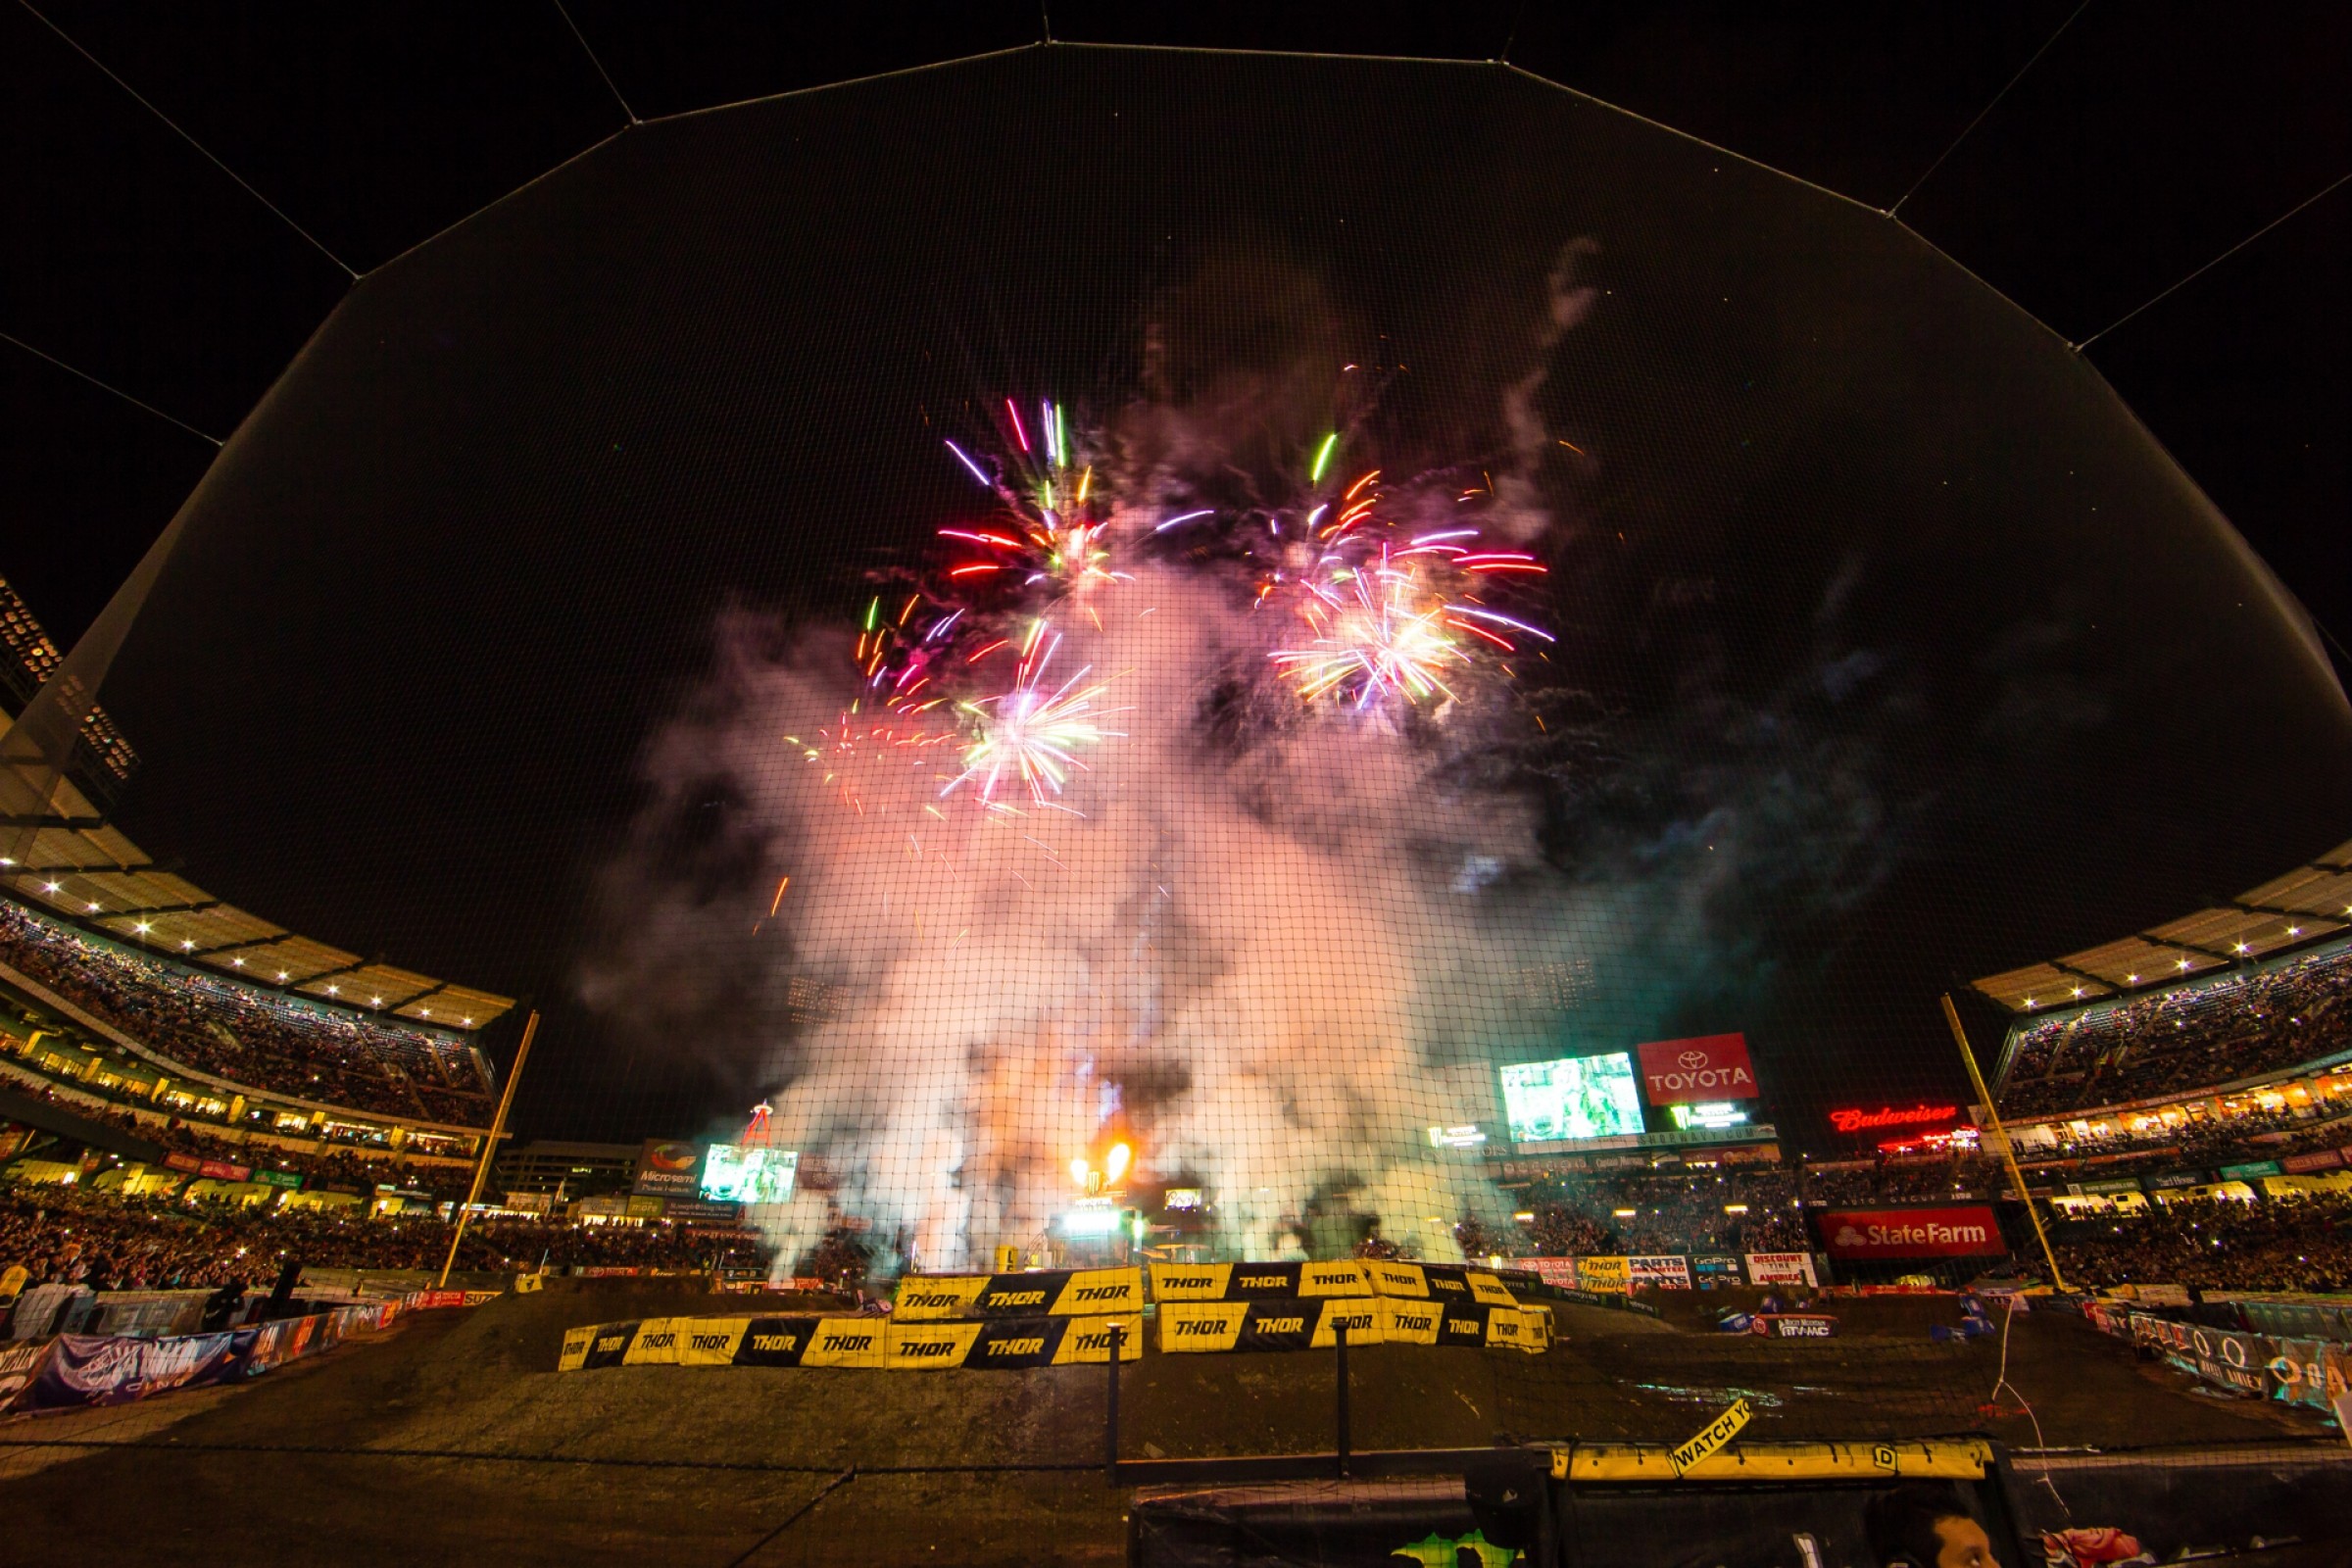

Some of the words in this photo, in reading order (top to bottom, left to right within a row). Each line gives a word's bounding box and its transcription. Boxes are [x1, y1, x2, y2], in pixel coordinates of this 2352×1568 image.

[1649, 1066, 1751, 1092] TOYOTA
[1830, 1105, 1956, 1131] Budweiser
[640, 1170, 697, 1185] Microsemi
[1589, 1261, 1621, 1270] THOR
[1629, 1257, 1683, 1267] PARTS
[1753, 1254, 1803, 1263] DISCOUNT
[1162, 1278, 1215, 1288] THOR
[1240, 1276, 1289, 1288] THOR
[1312, 1274, 1358, 1285] THOR
[1381, 1272, 1418, 1286] THOR
[1431, 1278, 1466, 1291] THOR
[1592, 1279, 1625, 1289] THOR
[1076, 1285, 1131, 1301] THOR
[1477, 1284, 1506, 1295] THOR
[905, 1294, 960, 1307] THOR
[989, 1291, 1046, 1306] THOR
[1176, 1320, 1228, 1336] THOR
[1255, 1318, 1304, 1334] THOR
[1396, 1314, 1432, 1330] THOR
[1448, 1319, 1480, 1334] THOR
[1495, 1323, 1519, 1337] THOR
[597, 1336, 622, 1351] THOR
[641, 1333, 674, 1348] THOR
[691, 1335, 730, 1349] THOR
[753, 1334, 796, 1351] THOR
[823, 1336, 872, 1350] THOR
[988, 1337, 1044, 1355] THOR
[1075, 1332, 1128, 1350] THOR
[564, 1341, 585, 1356] THOR
[901, 1342, 956, 1356] THOR
[1675, 1416, 1736, 1467] WATCH
